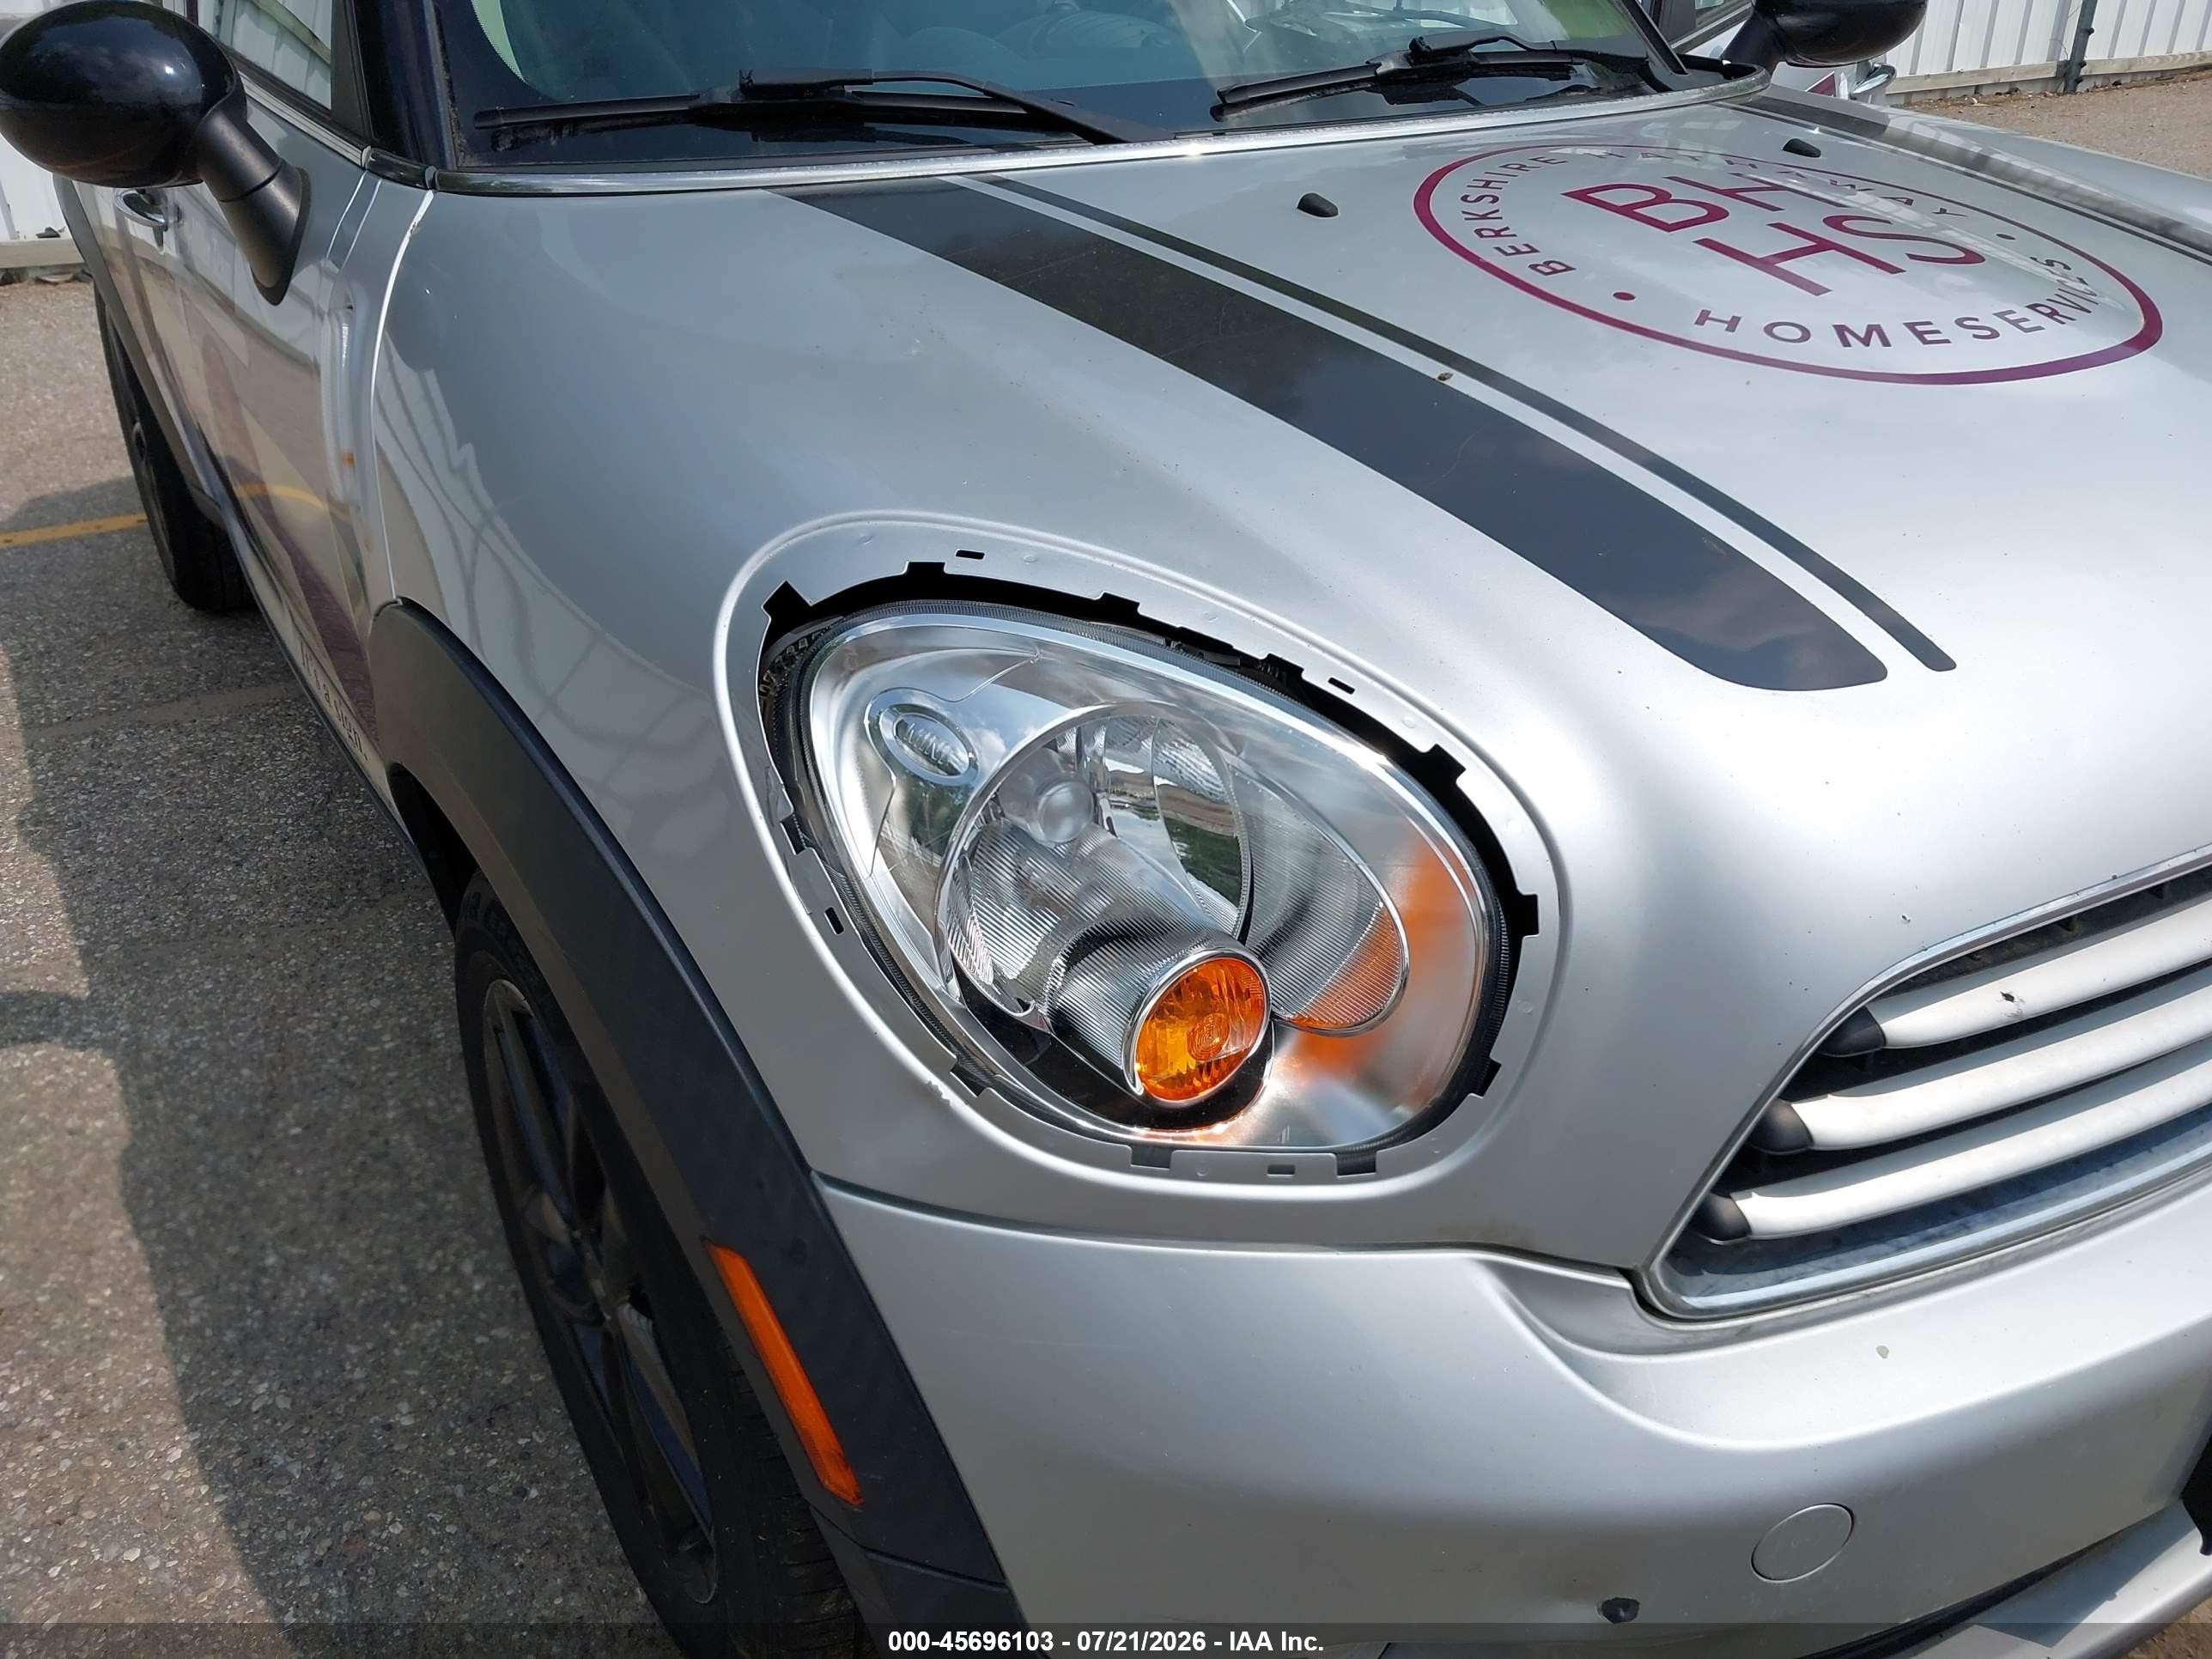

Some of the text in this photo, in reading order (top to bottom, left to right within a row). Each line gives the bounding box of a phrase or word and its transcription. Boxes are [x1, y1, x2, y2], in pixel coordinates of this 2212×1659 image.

[1460, 156, 1577, 276] BERKSHIRE
[1559, 173, 1850, 233] BH
[1692, 215, 1986, 296] HS
[1694, 256, 2099, 348] HOMESERVICES
